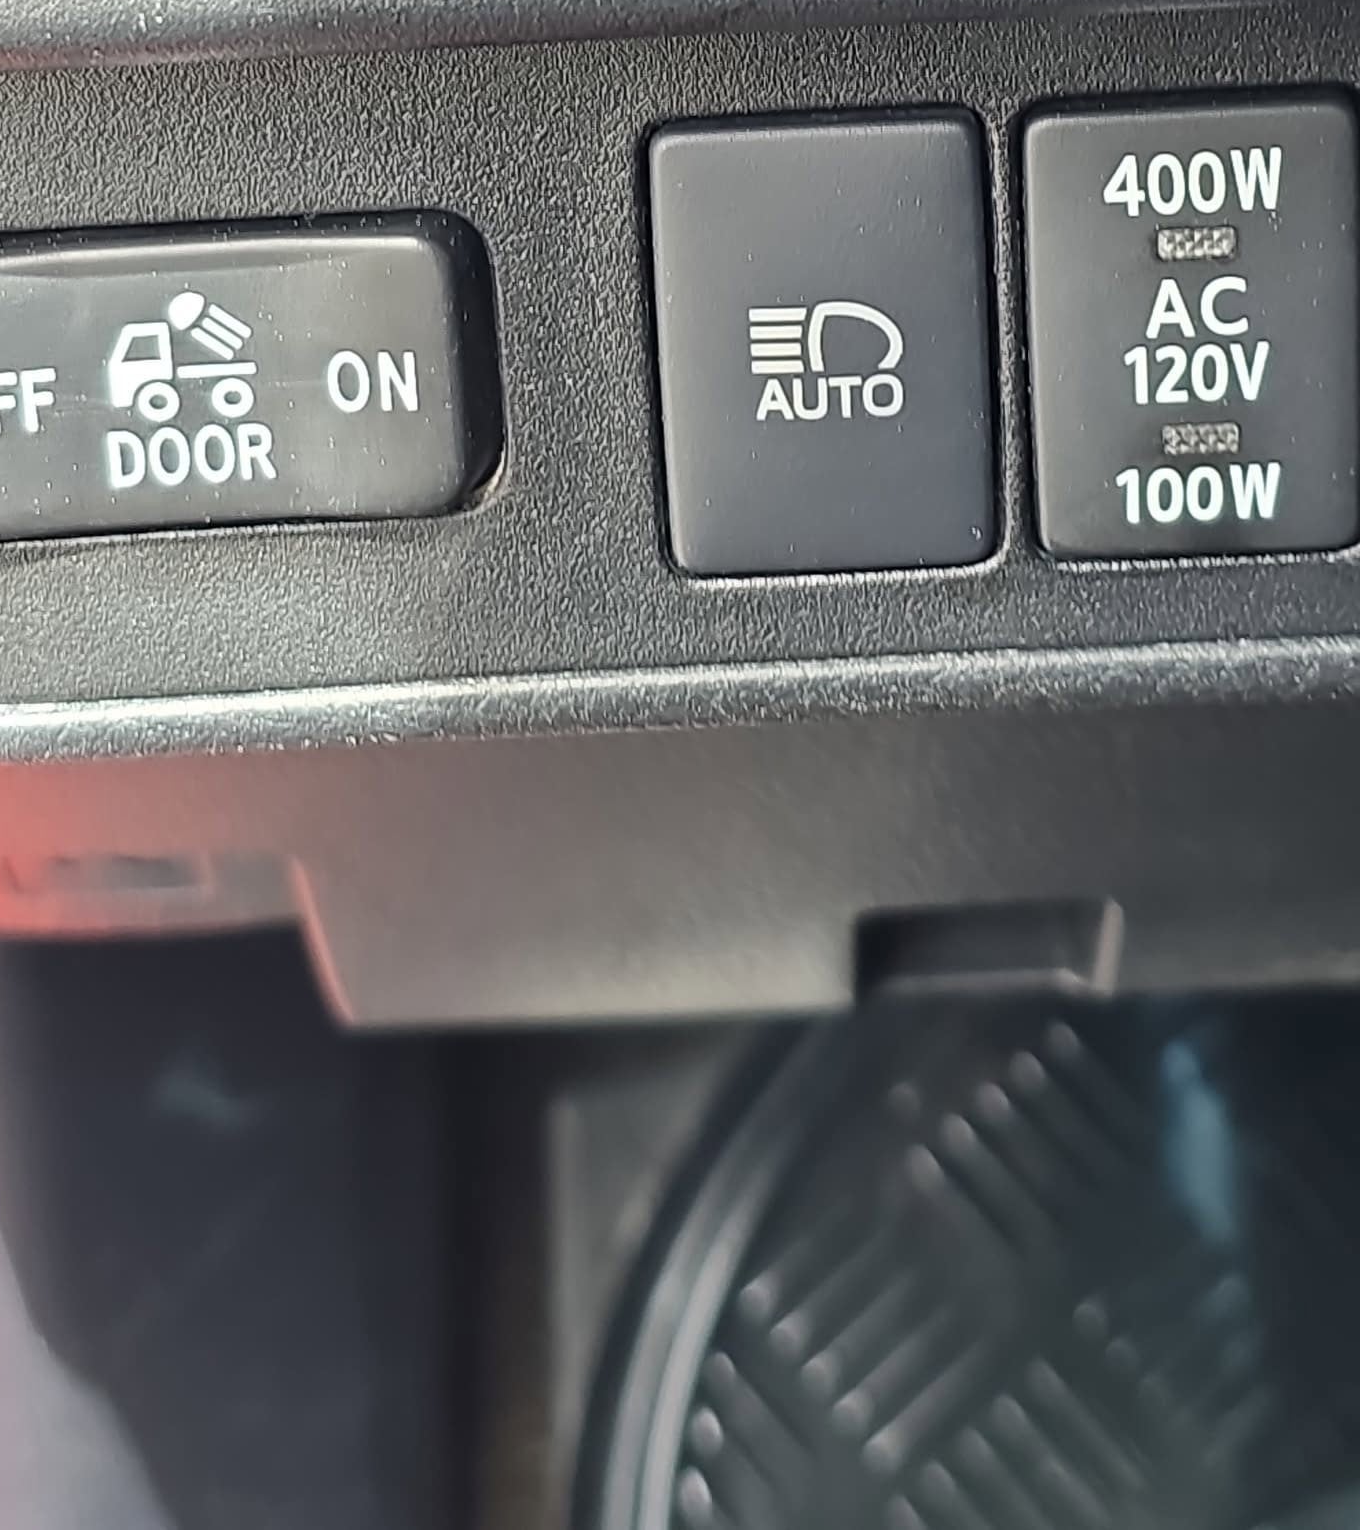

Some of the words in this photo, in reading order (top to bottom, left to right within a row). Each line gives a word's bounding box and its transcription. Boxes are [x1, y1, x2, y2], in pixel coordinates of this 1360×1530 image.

[1102, 146, 1283, 218] 400W
[1144, 275, 1250, 340] AC
[325, 349, 419, 415] ON
[755, 373, 905, 422] AUTO
[1123, 340, 1270, 406] 120V
[104, 422, 278, 490] DOOR
[1115, 461, 1282, 525] 100W
